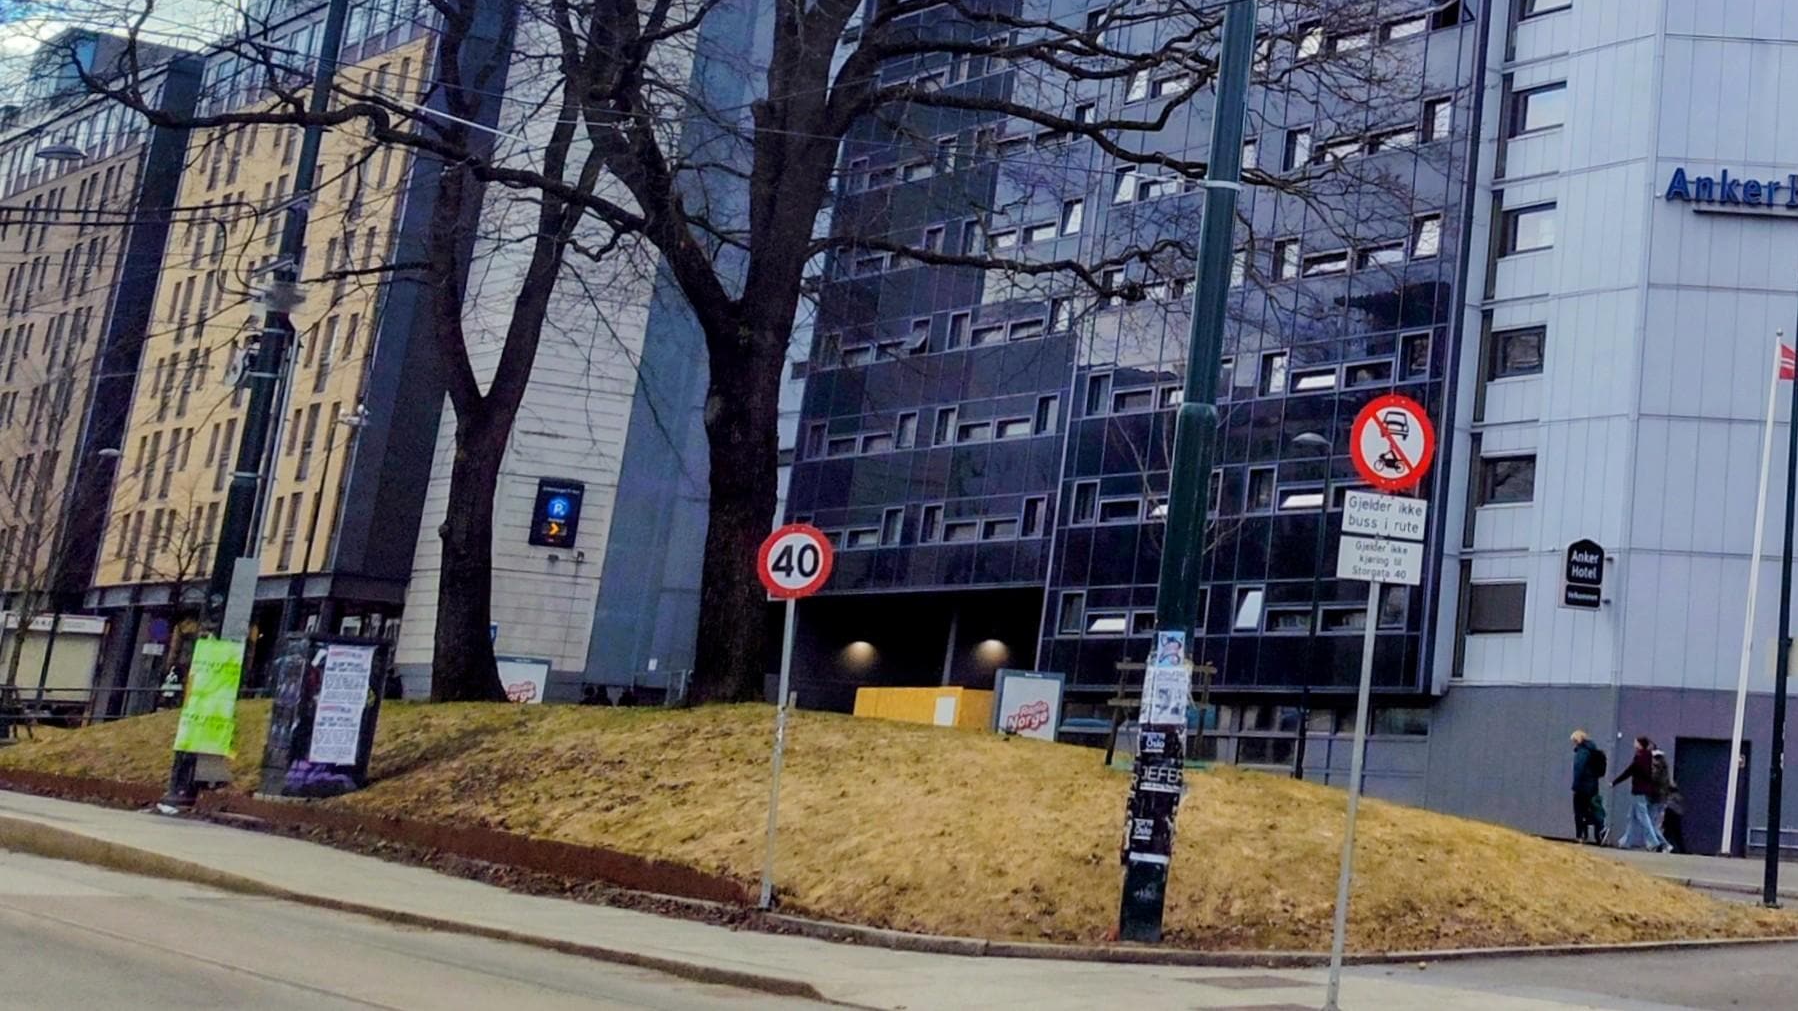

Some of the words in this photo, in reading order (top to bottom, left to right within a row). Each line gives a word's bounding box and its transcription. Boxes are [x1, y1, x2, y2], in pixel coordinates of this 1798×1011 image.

[1665, 166, 1780, 208] Anker
[1348, 495, 1392, 513] Gjelder
[1398, 502, 1423, 517] ikke
[1348, 513, 1378, 529] buss
[1393, 521, 1419, 534] rute
[1355, 541, 1386, 553] Gjelder
[1390, 545, 1408, 554] ikke
[1571, 550, 1600, 564] Anker
[771, 543, 820, 578] 40
[1395, 570, 1407, 579] 40
[1571, 565, 1597, 579] Hotel
[1007, 712, 1048, 731] Norge
